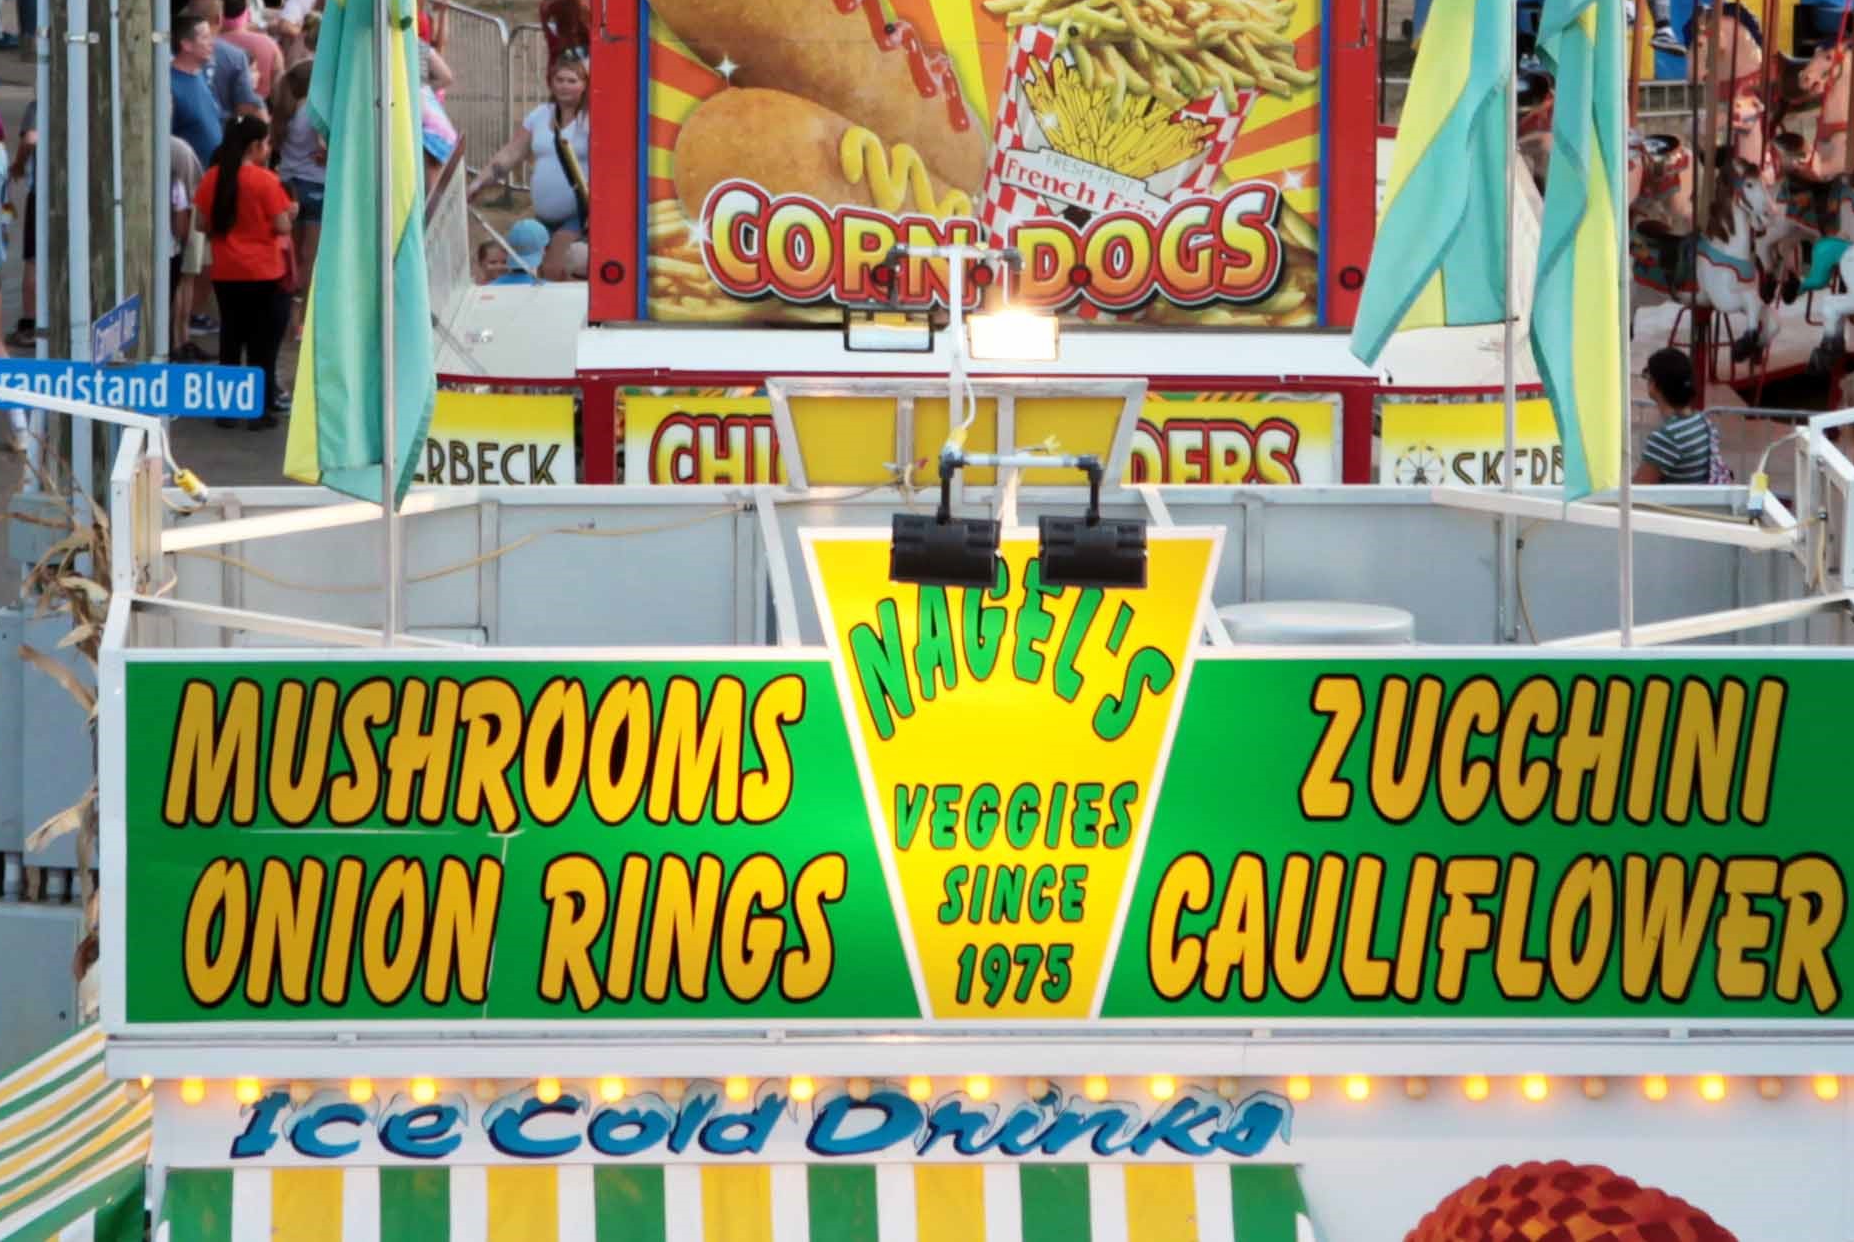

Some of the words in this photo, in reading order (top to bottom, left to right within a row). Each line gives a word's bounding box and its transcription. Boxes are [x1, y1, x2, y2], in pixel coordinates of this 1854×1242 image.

[1004, 157, 1097, 206] French
[701, 178, 982, 310] CORN
[1006, 180, 1286, 314] DOGS
[183, 371, 257, 411] Blvd
[848, 556, 1176, 742] NAGEL'S
[161, 675, 807, 835] MUSHROOMS
[1297, 674, 1790, 827] ZUCCHINI
[894, 781, 1139, 851] VEGGIES
[182, 856, 505, 1008] ONION
[537, 850, 849, 1013] RINGS
[937, 863, 1089, 925] SINCE
[1147, 850, 1850, 1014] CAULIFLOWER
[955, 942, 1074, 1008] 1975
[231, 1090, 469, 1158] Ice
[483, 1083, 793, 1158] Cold
[806, 1083, 1292, 1157] Drinks
